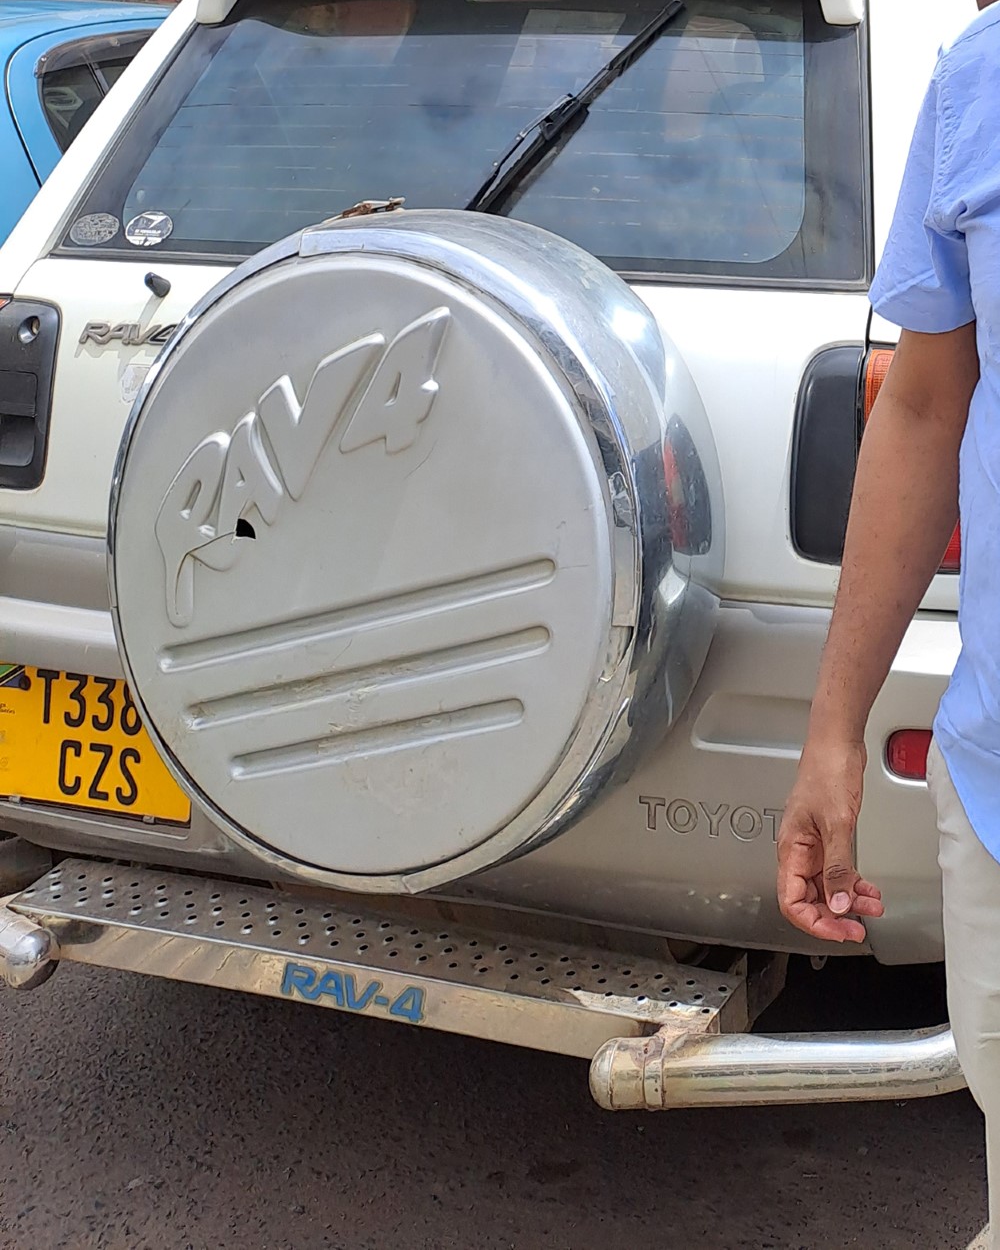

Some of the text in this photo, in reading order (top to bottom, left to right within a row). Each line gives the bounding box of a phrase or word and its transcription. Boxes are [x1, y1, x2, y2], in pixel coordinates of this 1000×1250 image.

[36, 668, 142, 736] T338
[58, 739, 141, 806] CZS
[281, 962, 424, 1024] RAV-4
